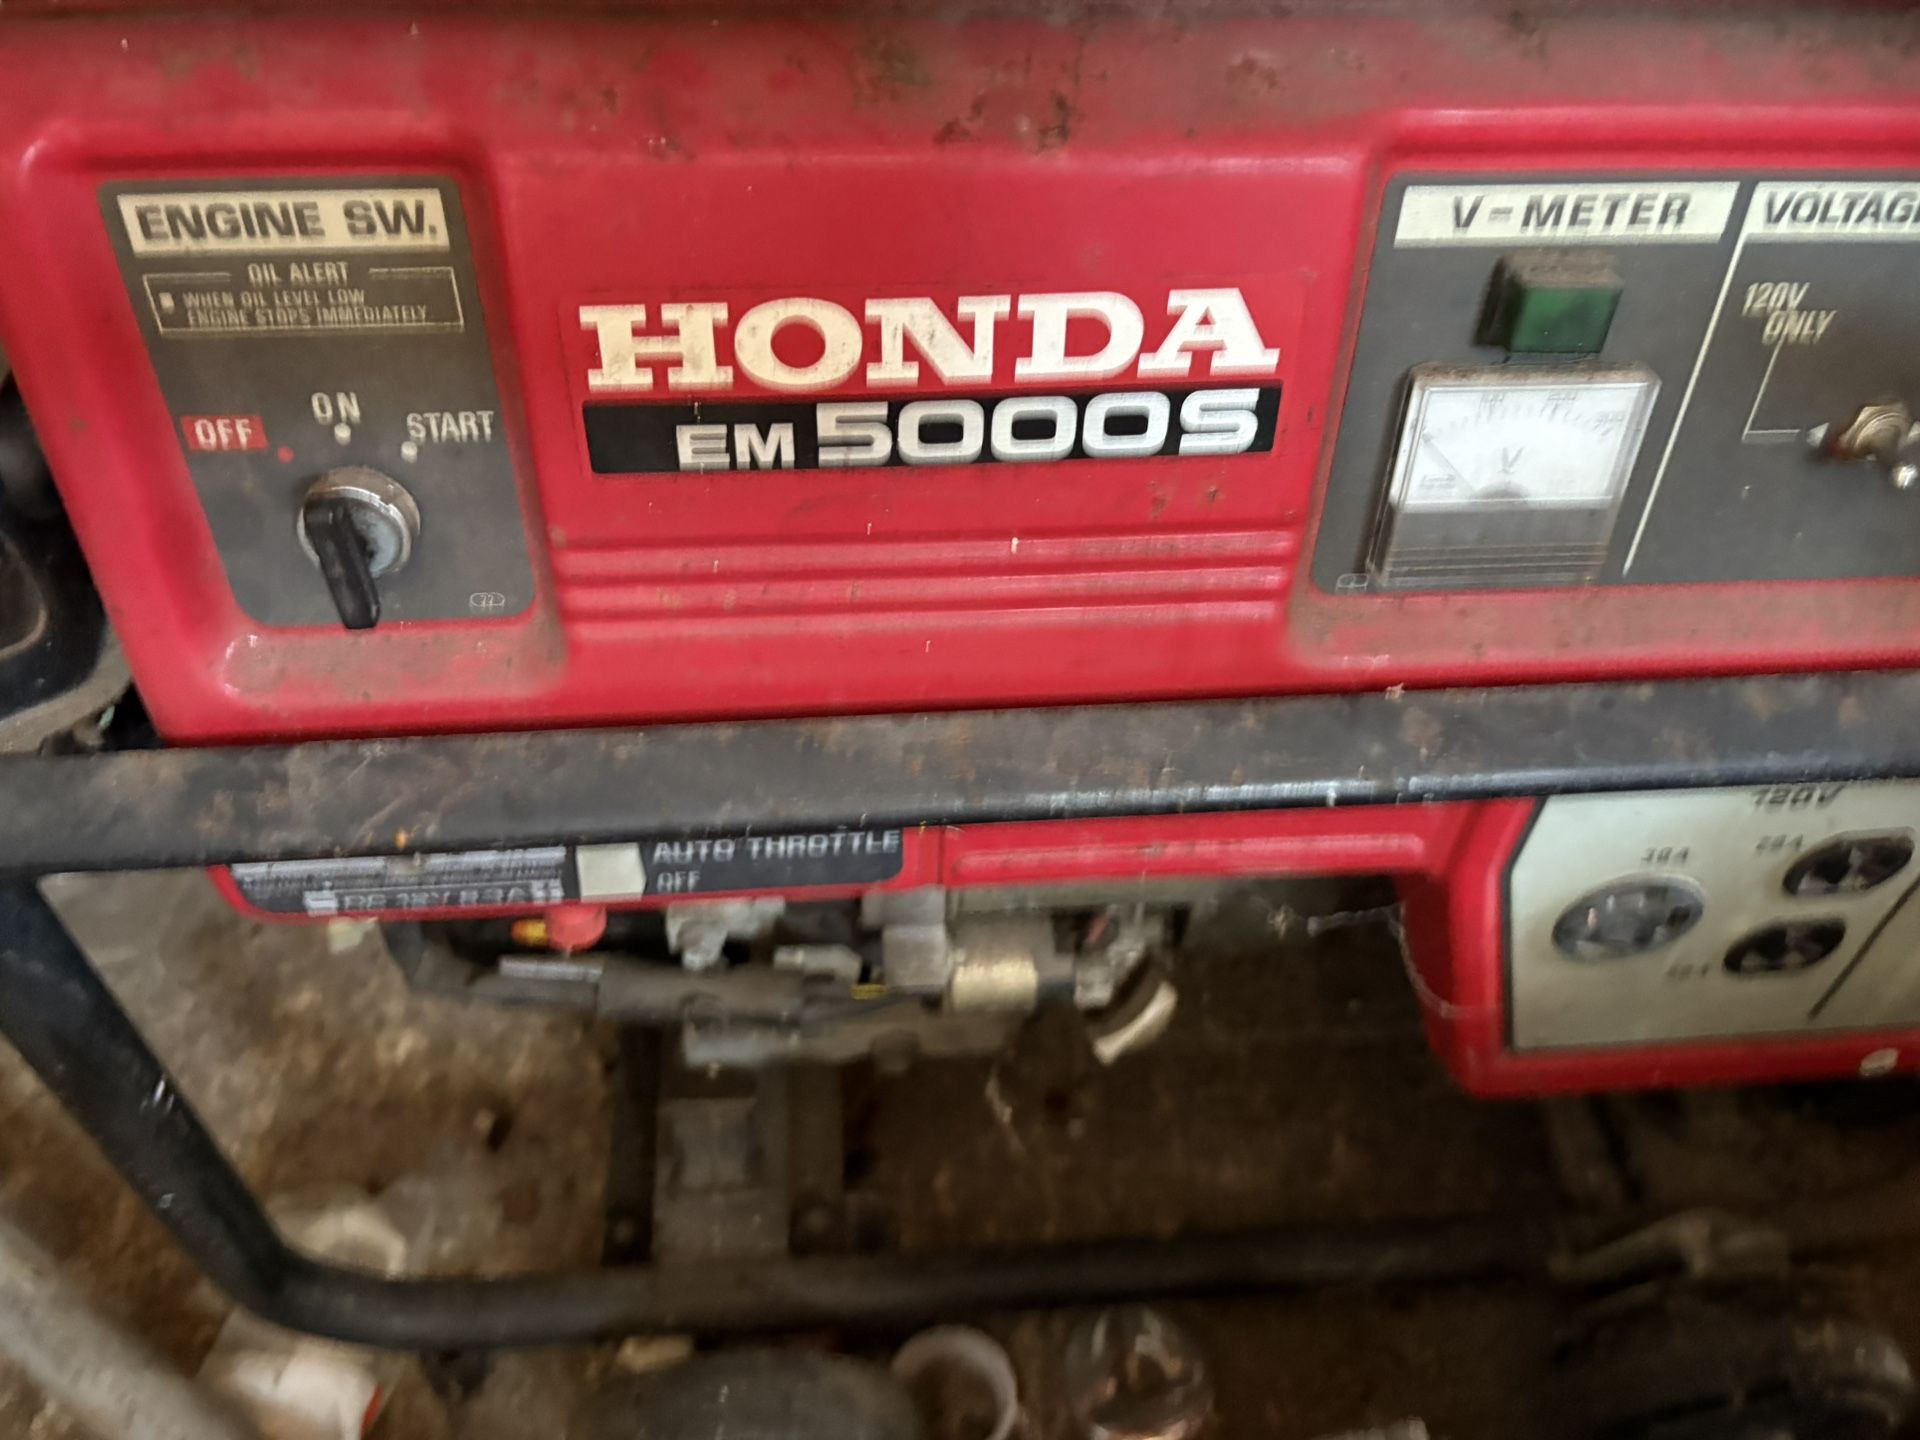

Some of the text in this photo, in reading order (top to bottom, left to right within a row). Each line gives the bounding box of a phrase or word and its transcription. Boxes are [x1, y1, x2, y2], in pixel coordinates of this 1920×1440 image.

[136, 198, 438, 240] ENGINE SW.
[247, 261, 349, 287] OIL ALERT
[182, 288, 365, 309] WHEN OIL LEVEL LOW
[1742, 281, 1810, 316] 120V
[186, 304, 426, 328] ENGINE STOPS IMMEDIATELY
[1762, 310, 1837, 345] ONLY
[578, 286, 1280, 391] HONDA
[311, 391, 361, 424] ON
[194, 418, 253, 451] OFF
[406, 411, 494, 444] START
[652, 829, 901, 865] AUTO THROTTLE
[656, 869, 701, 893] OFF
